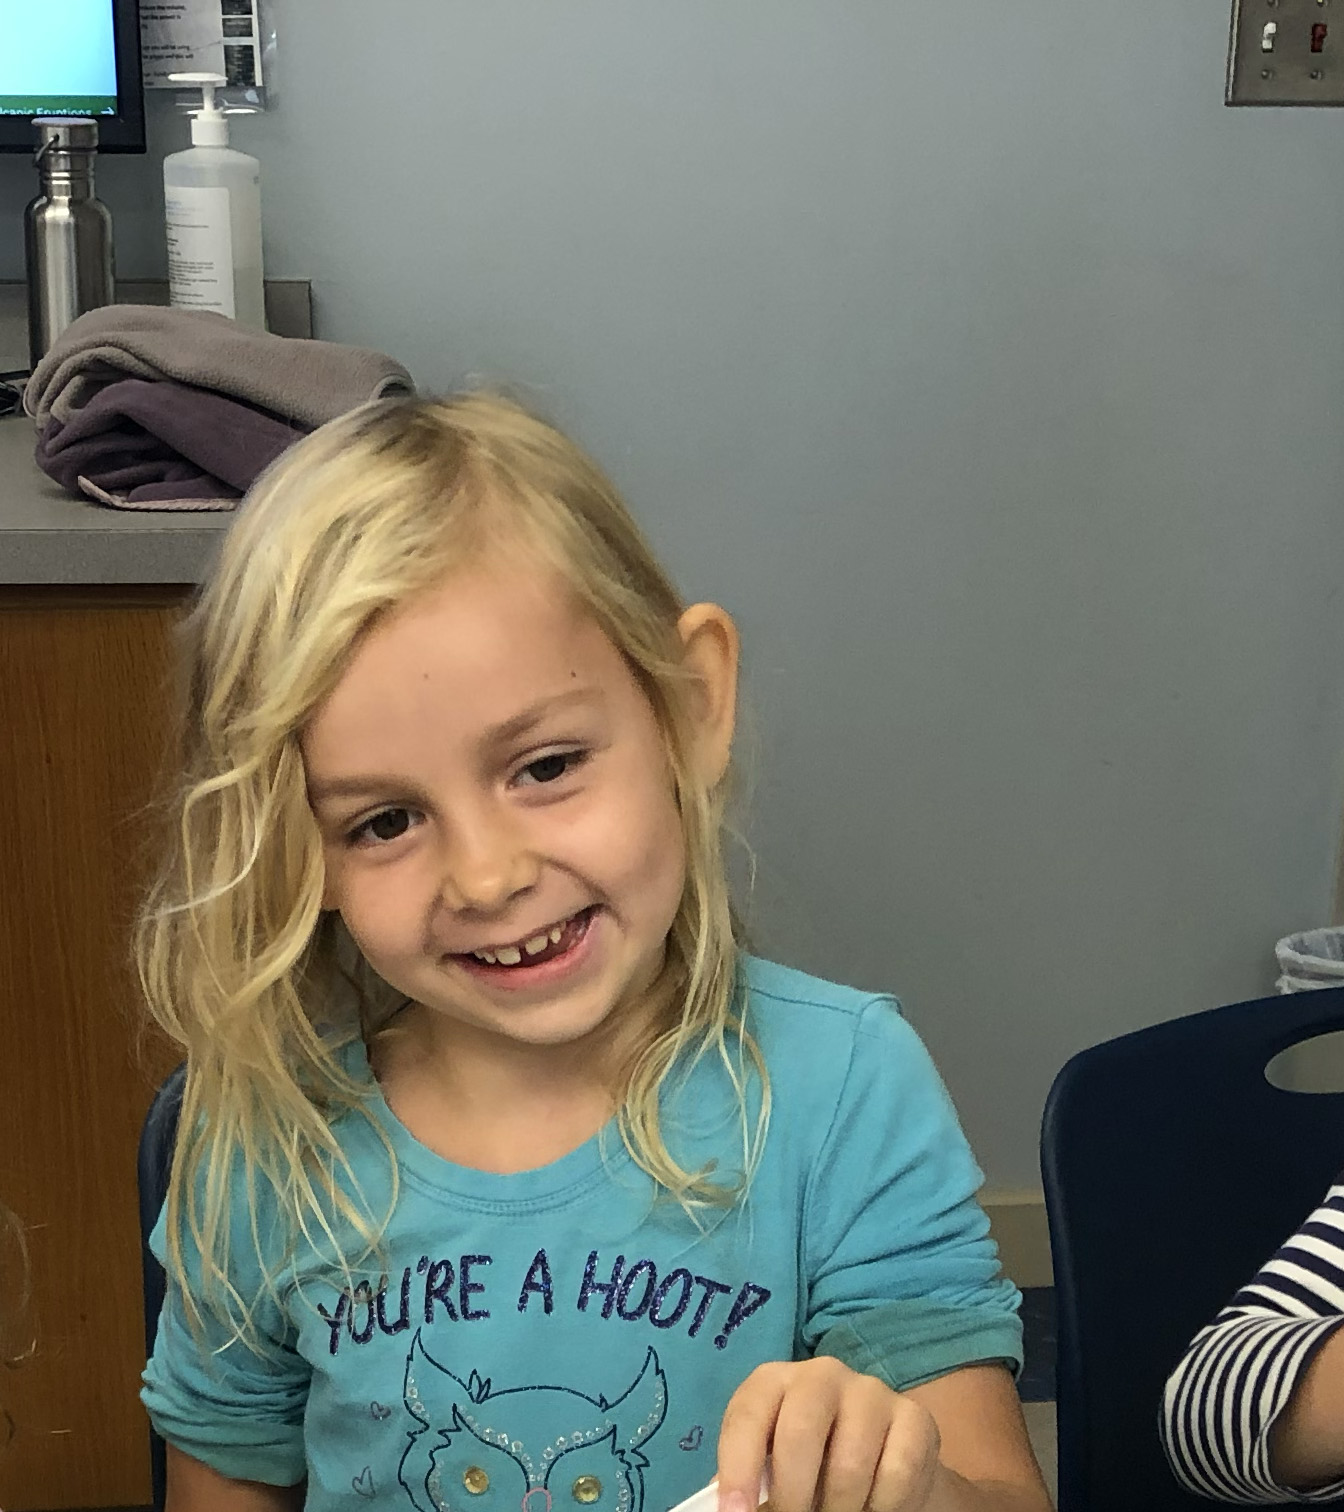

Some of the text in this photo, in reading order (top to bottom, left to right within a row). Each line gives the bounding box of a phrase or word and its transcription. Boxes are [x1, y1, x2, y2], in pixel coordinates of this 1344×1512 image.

[316, 1247, 773, 1356] YOU'RE A HOOT!
